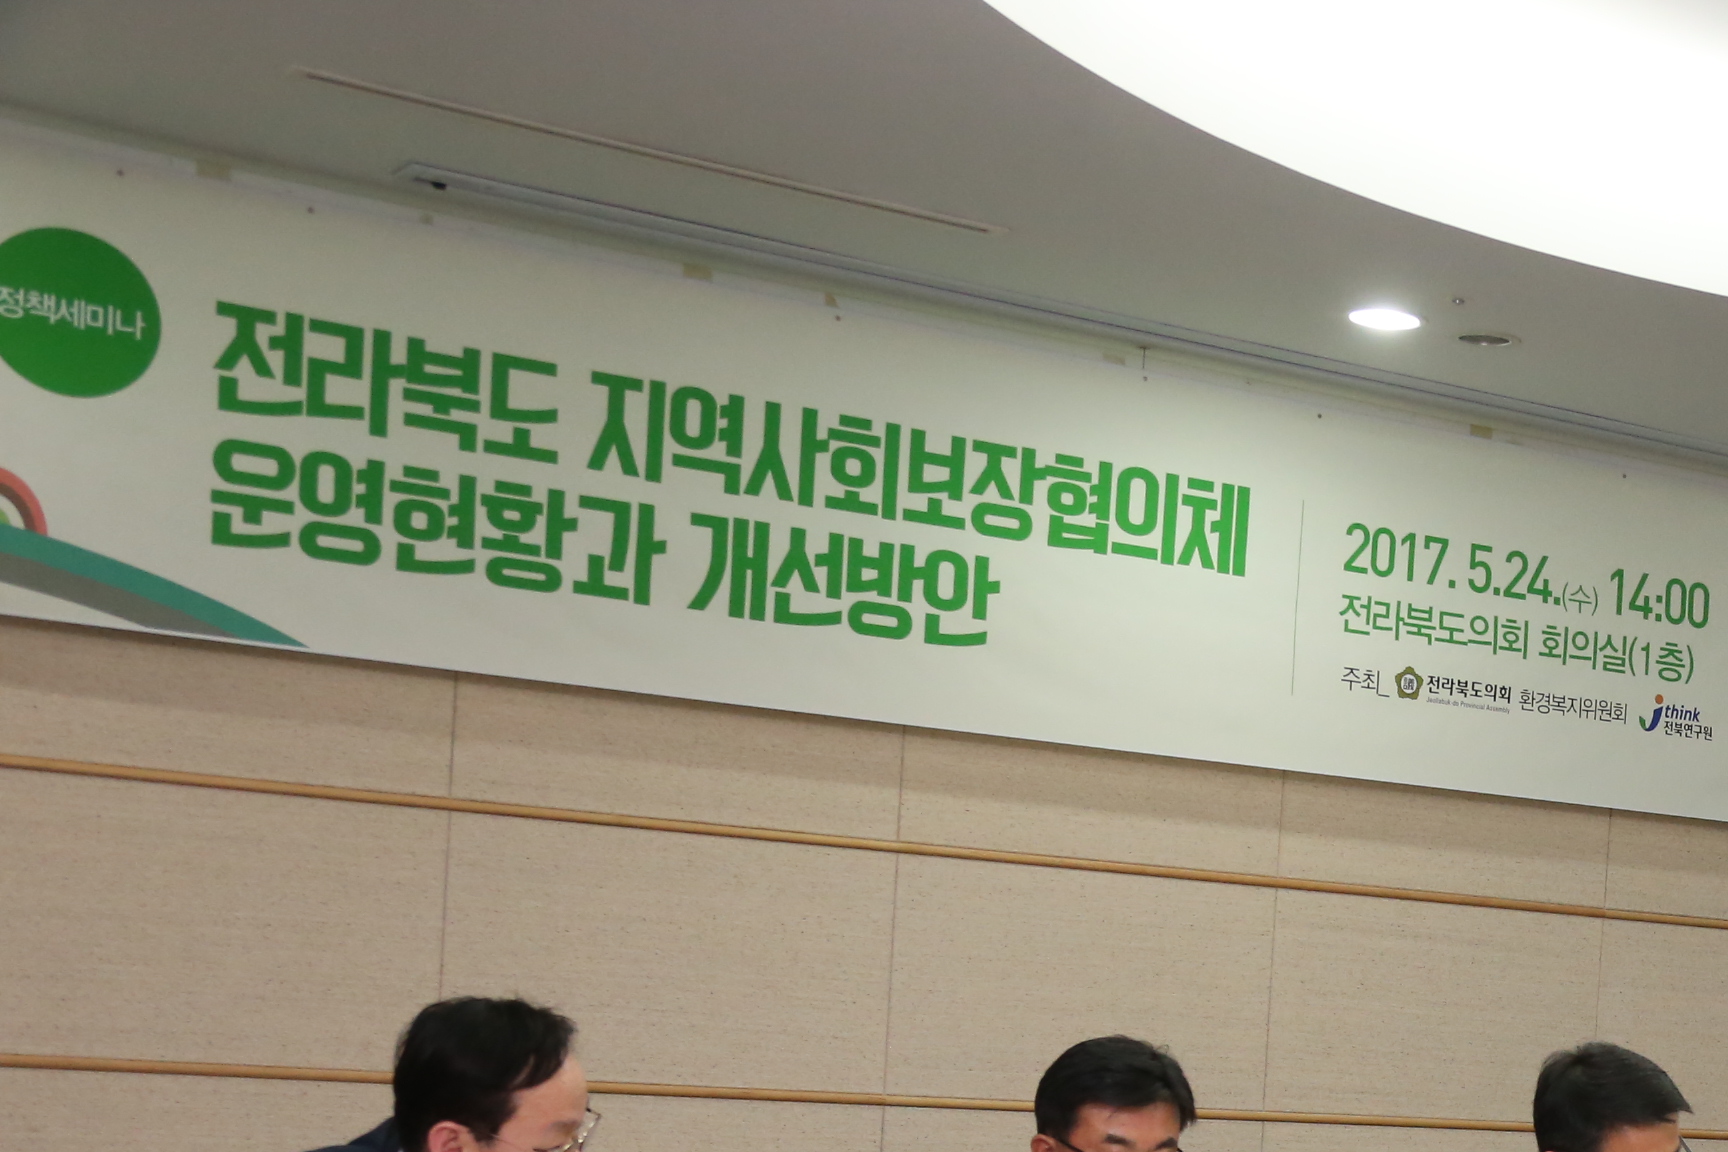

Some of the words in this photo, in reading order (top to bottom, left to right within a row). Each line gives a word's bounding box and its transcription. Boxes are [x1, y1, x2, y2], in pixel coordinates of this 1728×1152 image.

[0, 285, 147, 341] 정책세미나
[212, 300, 559, 471] 전라북도
[586, 370, 1251, 578] 지역사회보장협의체
[210, 438, 668, 607] 운영현황과
[686, 512, 1001, 648] 개선방안
[1610, 567, 1710, 630] 14:00
[1338, 593, 1530, 660] 전라북도의회
[1538, 623, 1696, 686] 회의실(1층)
[1426, 675, 1512, 705] 전라북도의회
[1518, 688, 1628, 725] 환경복지위원회
[1664, 704, 1701, 723] think
[1663, 719, 1713, 742] 전북연구원
